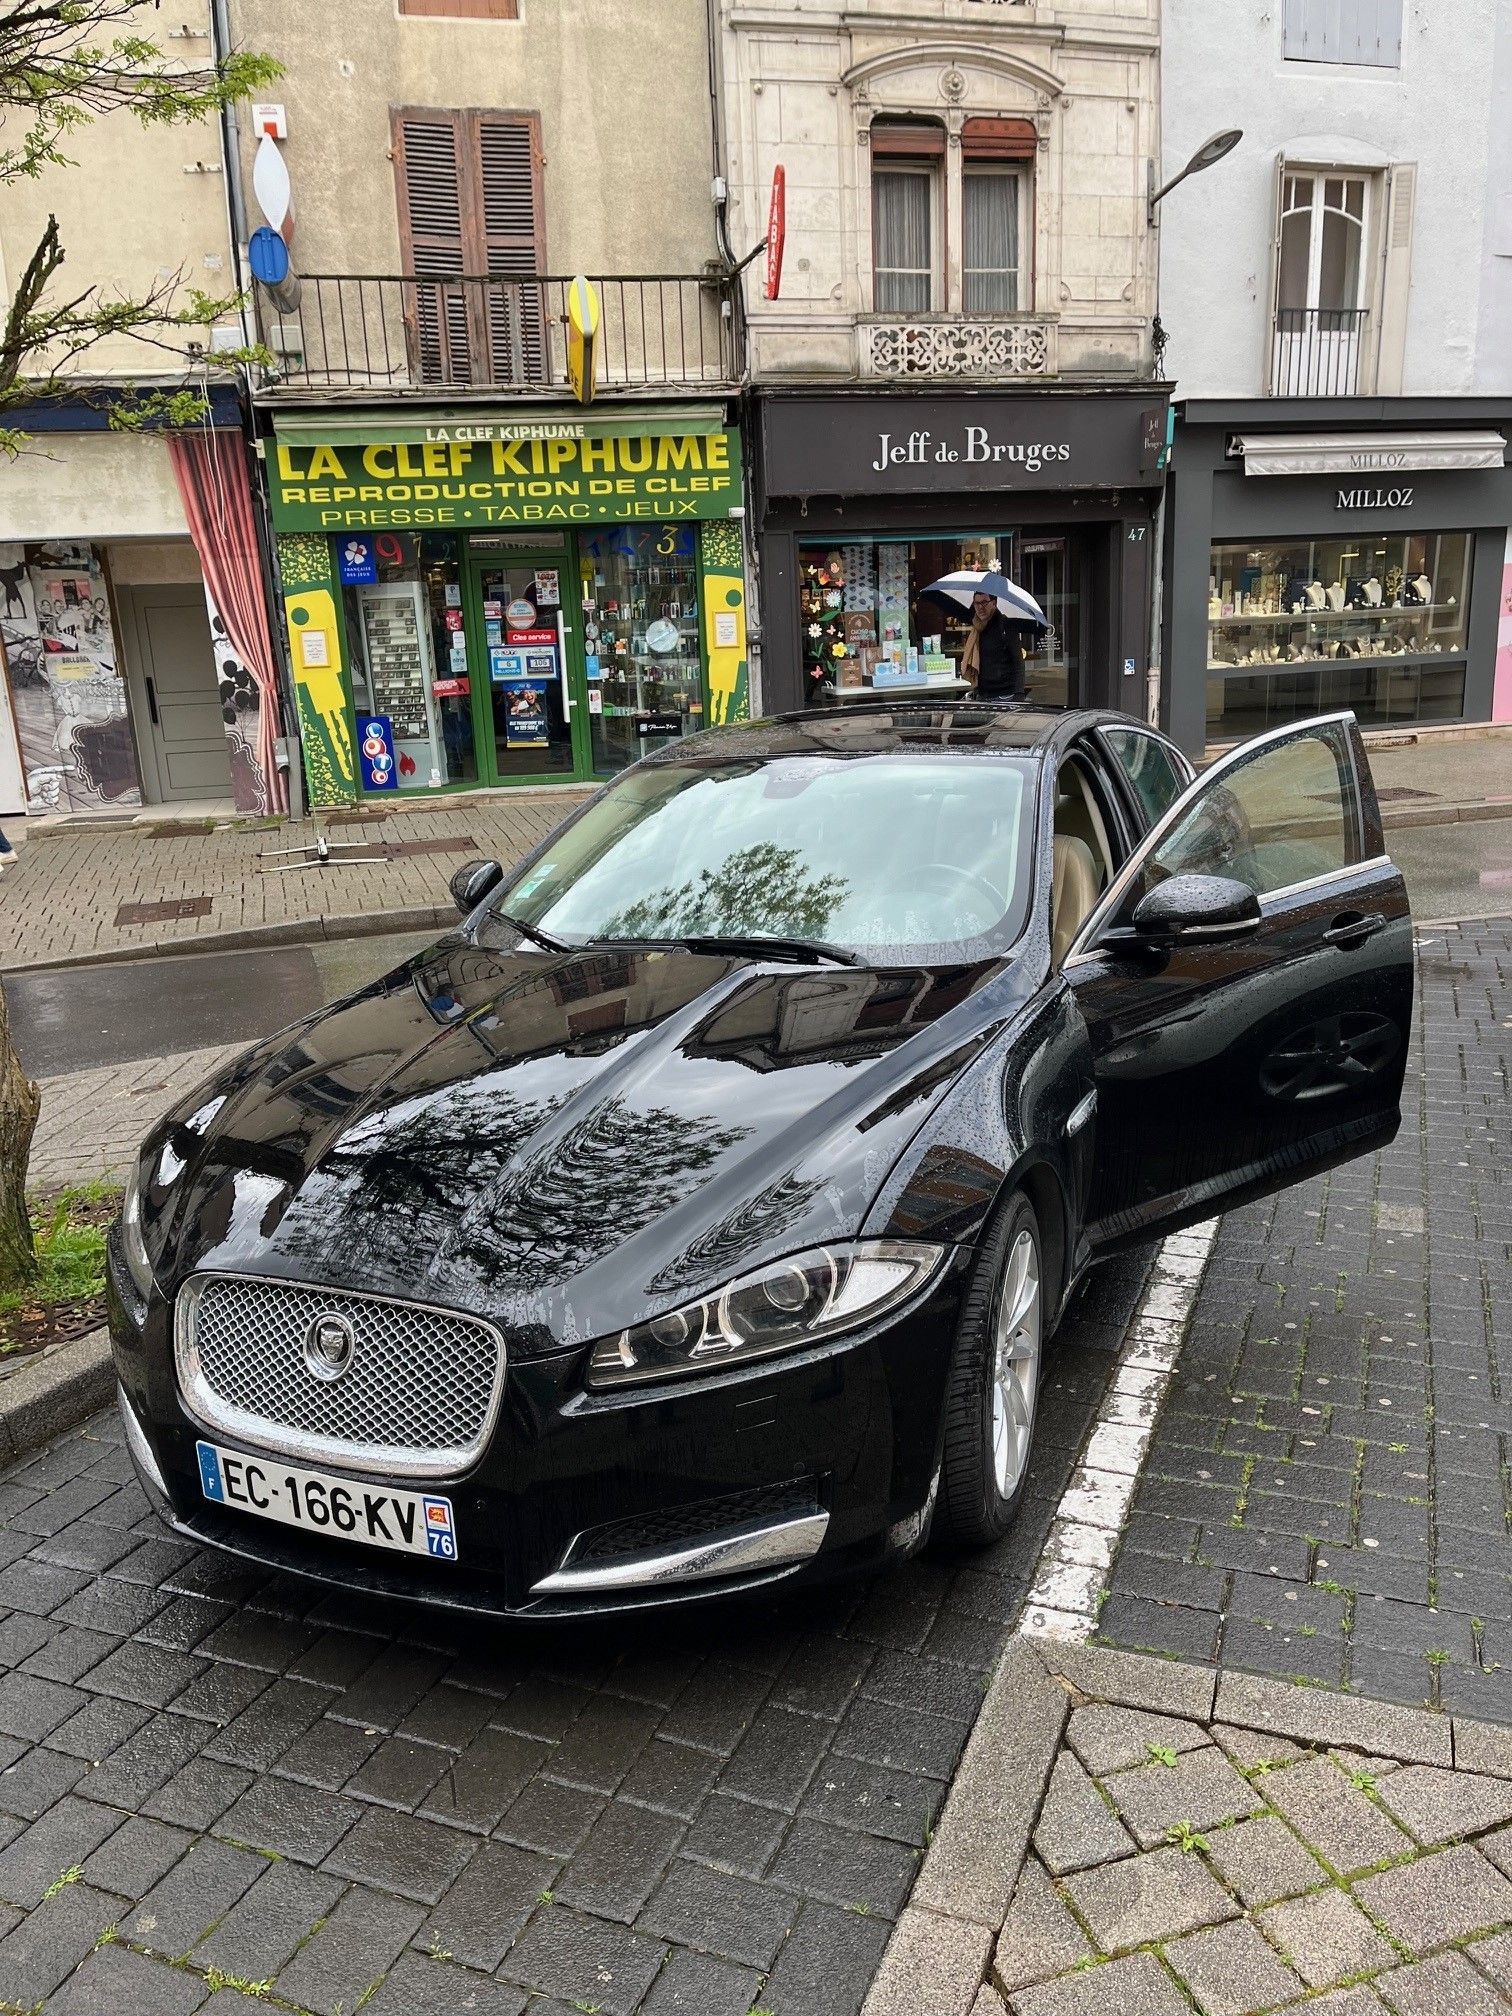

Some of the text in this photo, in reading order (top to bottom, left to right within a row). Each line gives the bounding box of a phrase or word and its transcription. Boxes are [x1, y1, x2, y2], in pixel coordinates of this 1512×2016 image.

[770, 184, 779, 282] TABAC
[426, 424, 585, 441] LA CLEF KIPHUME
[277, 435, 730, 481] LA CLEF KIPHUME
[872, 426, 1071, 472] Jeff de Bruges
[1350, 453, 1407, 468] MILLOZ
[282, 476, 731, 504] REPRODUCTION DE CLEF
[1336, 488, 1414, 509] MILLOZ
[321, 500, 698, 526] PRESSE TABAC JEUX
[656, 525, 679, 554] 3
[1128, 527, 1146, 541] 47
[375, 533, 404, 565] 9
[208, 1478, 215, 1490] F
[222, 1457, 415, 1543] EC-166-KV
[428, 1533, 452, 1556] 76
